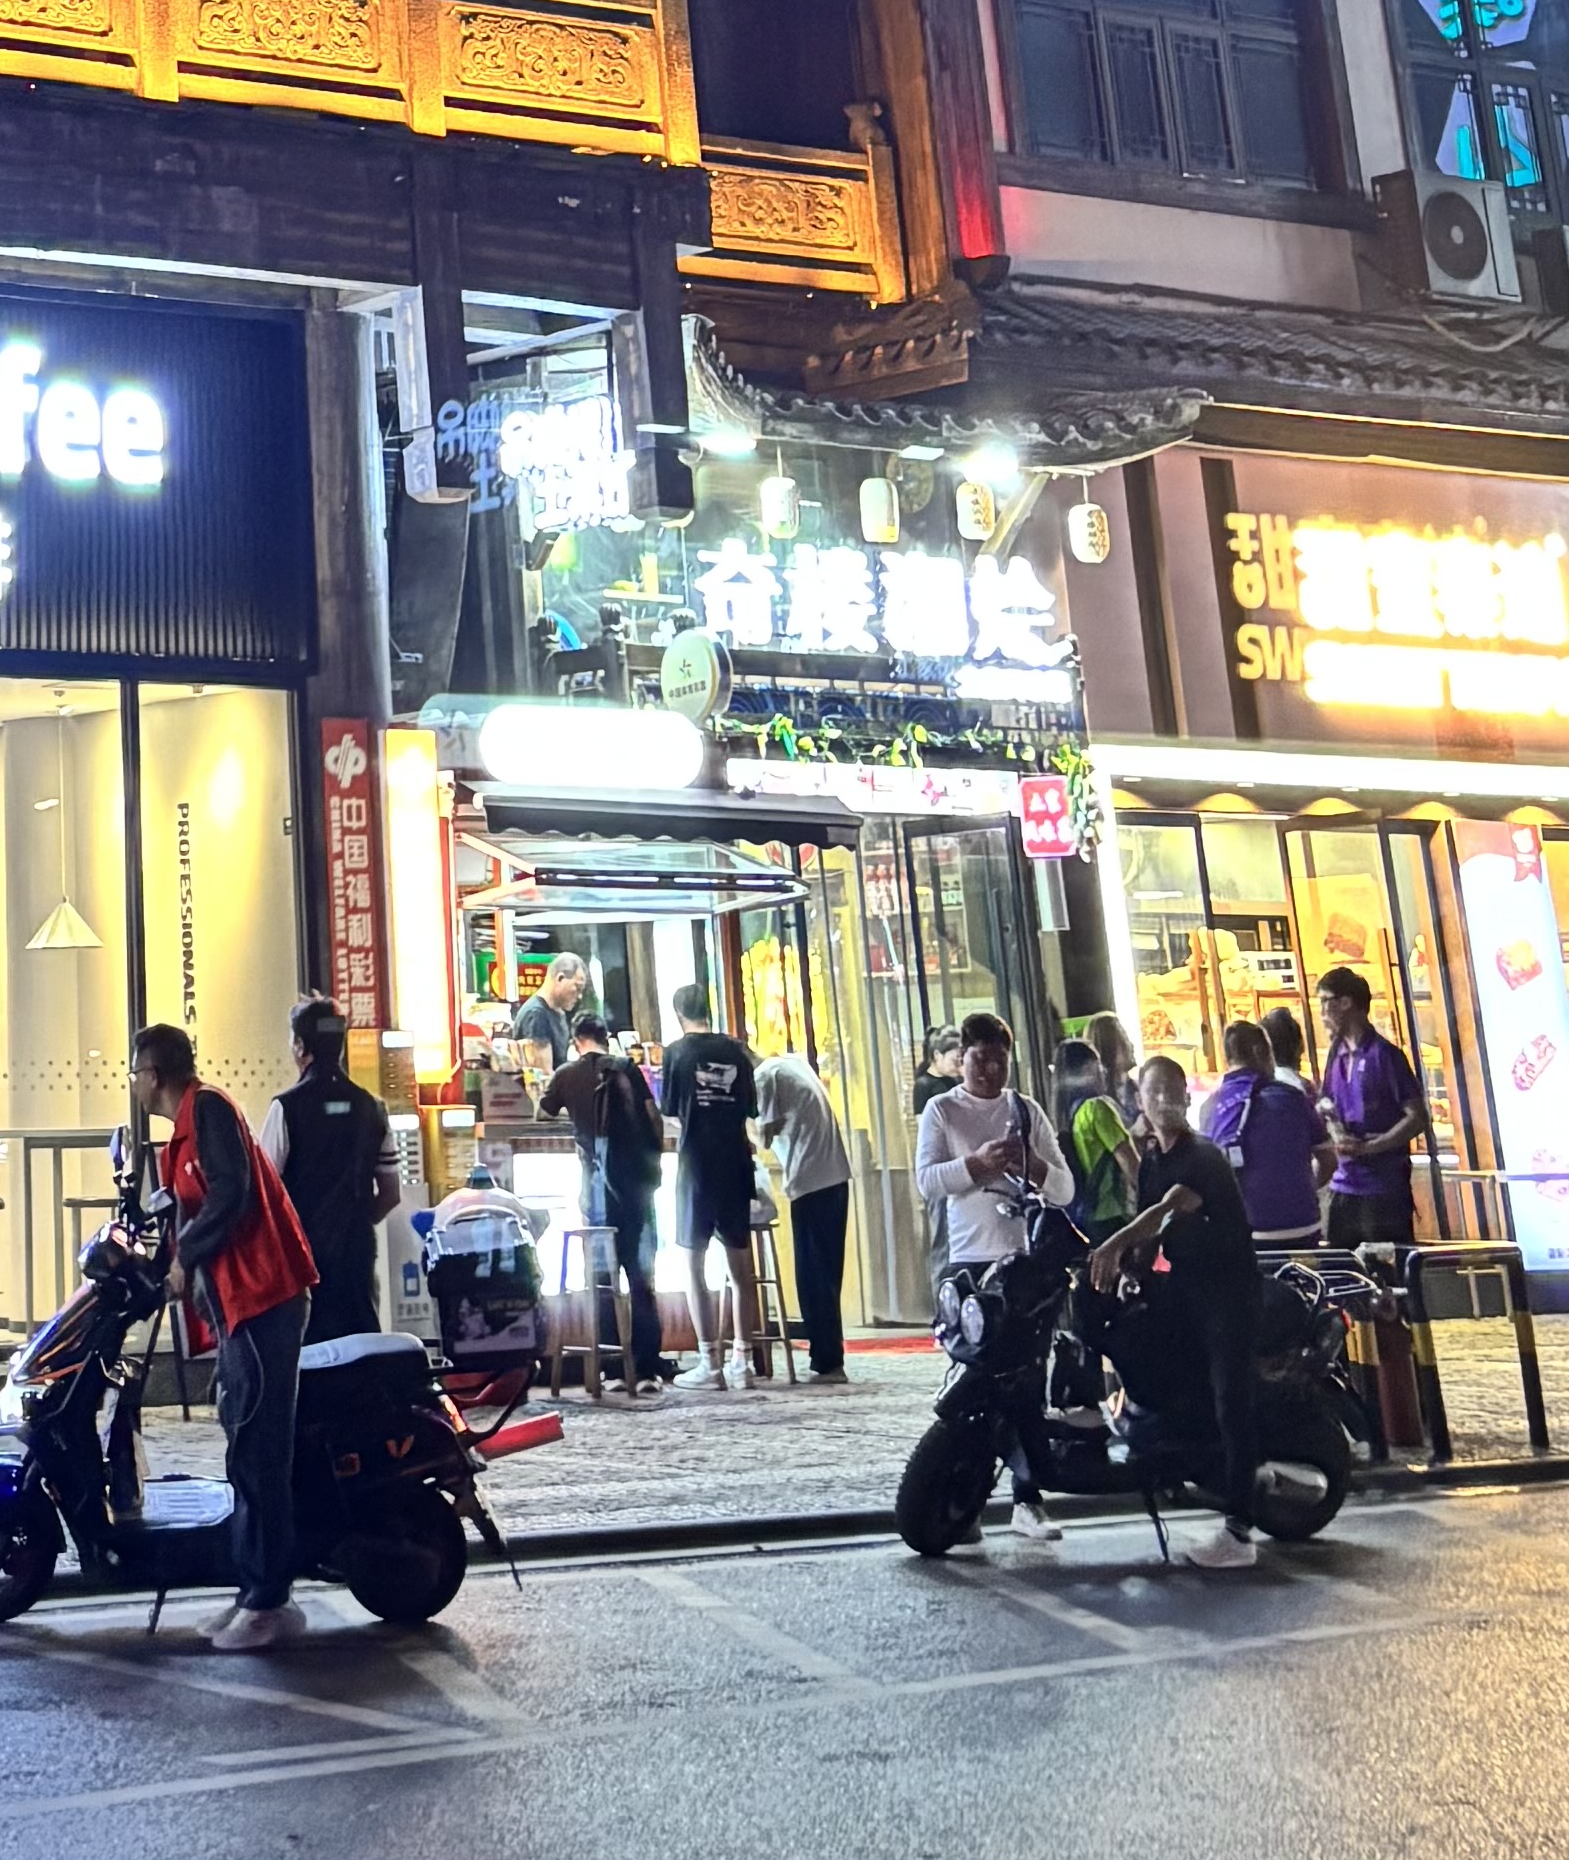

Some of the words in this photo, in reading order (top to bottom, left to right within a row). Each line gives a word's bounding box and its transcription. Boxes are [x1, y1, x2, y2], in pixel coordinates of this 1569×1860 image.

[177, 802, 198, 1026] PROFESSIONALS
[342, 796, 377, 1029] 中国福利彩票
